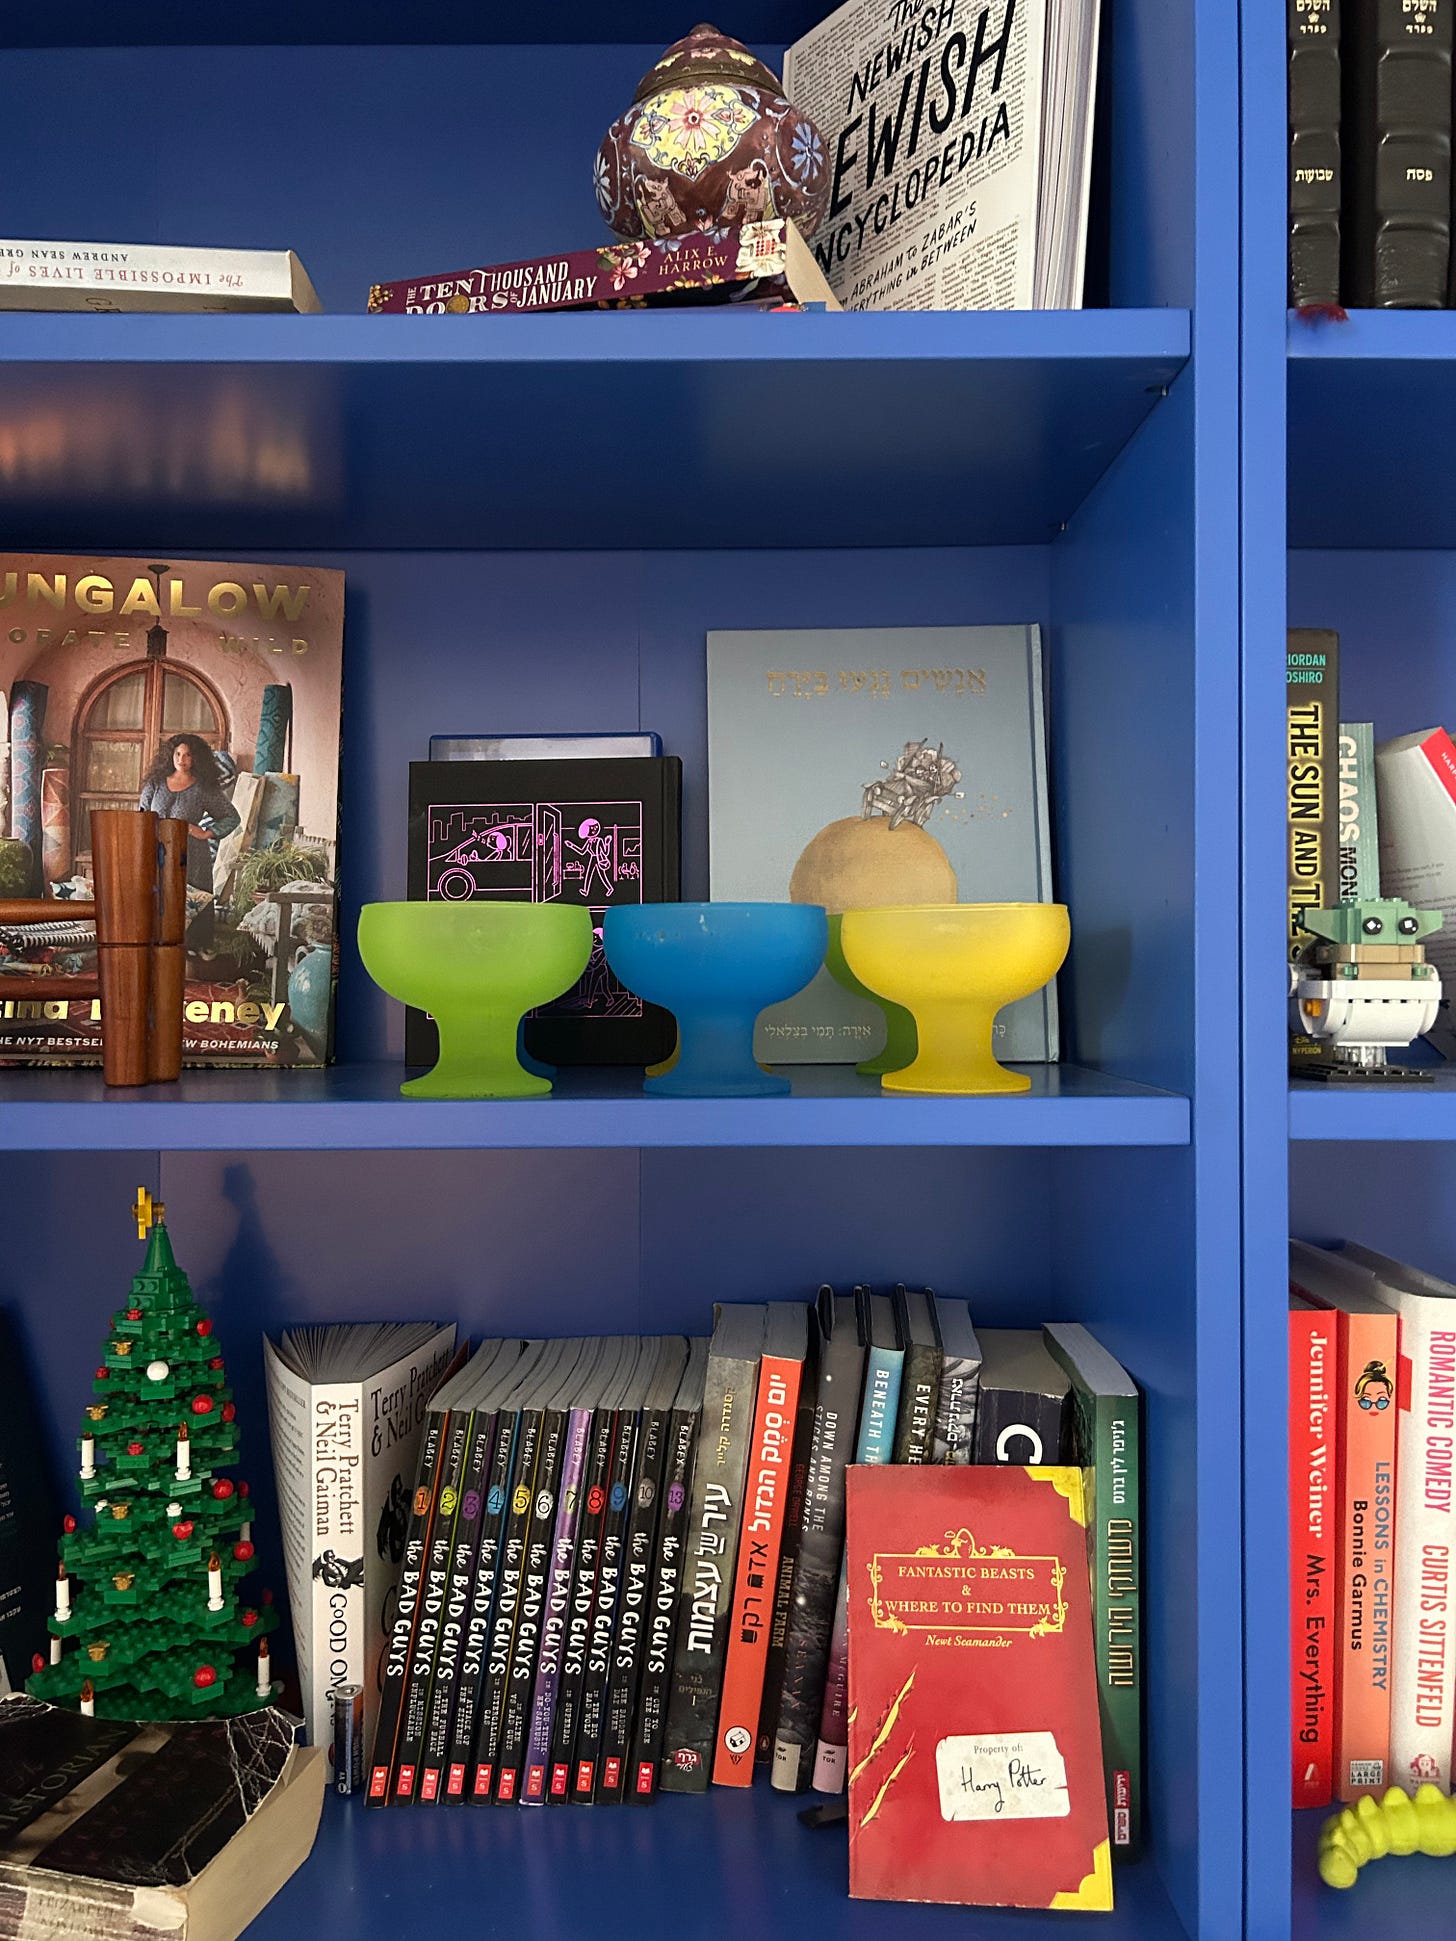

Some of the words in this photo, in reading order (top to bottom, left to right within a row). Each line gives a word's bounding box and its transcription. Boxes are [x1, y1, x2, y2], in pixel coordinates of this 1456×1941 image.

[885, 0, 924, 32] The
[847, 0, 956, 115] NEWISH
[828, 0, 1017, 221] EWISH
[815, 102, 1010, 273] NCYCLOPEDIA
[1295, 168, 1333, 183] שבועות
[1406, 168, 1433, 181] פסח
[31, 248, 65, 260] SEAN
[72, 251, 128, 263] ANDREW
[658, 256, 729, 276] HARROW
[664, 248, 699, 263] ALIX
[852, 254, 904, 297] ABRAHAM
[907, 244, 918, 261] to
[922, 200, 977, 251] ZABAR'S
[906, 264, 918, 279] in
[920, 219, 978, 270] BETWEEN
[7, 260, 21, 278] of
[29, 265, 84, 280] LIVES
[94, 268, 211, 285] IMPOSSIBLE
[219, 273, 244, 287] The
[419, 278, 475, 300] TEN
[470, 261, 569, 293] THOUSAND
[406, 287, 416, 304] THE
[516, 276, 597, 308] JANUARY
[1290, 705, 1320, 758] THE
[1290, 766, 1320, 820] SUN
[1338, 736, 1360, 843] CHAOS
[1292, 831, 1318, 878] AND
[16, 1037, 44, 1045] NYT
[200, 1040, 279, 1050] BOHEMIANS
[1309, 1330, 1328, 1440] Jennifer
[1427, 1331, 1456, 1429] ROMANTIC
[316, 1401, 336, 1416] &
[333, 1399, 358, 1448] Terry
[371, 1387, 407, 1423] Terry
[867, 1369, 890, 1439] BENEATH
[911, 1384, 931, 1441] EVERY
[316, 1422, 336, 1462] Neil
[371, 1425, 382, 1457] &
[387, 1406, 412, 1448] Neil
[497, 1428, 511, 1467] BLABEY
[523, 1428, 537, 1467] BLABEY
[572, 1427, 585, 1466] BLABEY
[597, 1429, 609, 1467] BLABEY
[619, 1425, 632, 1464] BLABEY
[647, 1421, 659, 1460] BLABEY
[676, 1426, 689, 1465] BLABEY
[811, 1405, 824, 1452] STICKS
[822, 1412, 838, 1451] DOWN
[424, 1429, 438, 1468] BLABEY
[450, 1429, 464, 1468] BLABEY
[472, 1433, 486, 1473] BLABEY
[545, 1433, 558, 1472] BLABEY
[1111, 1461, 1128, 1475] לין
[808, 1457, 817, 1483] AND
[816, 1455, 832, 1501] AMONG
[1424, 1436, 1453, 1514] COMEDY
[316, 1467, 337, 1536] Gaiman
[339, 1455, 359, 1535] Pratchett
[417, 1493, 425, 1510] 1
[441, 1492, 455, 1509] 2
[464, 1496, 477, 1514] 3
[489, 1491, 500, 1509] 4
[515, 1490, 527, 1508] 5
[538, 1495, 550, 1514] 6
[566, 1490, 576, 1509] 7
[589, 1490, 600, 1509] 8
[613, 1487, 624, 1505] 9
[640, 1486, 652, 1498] 10
[702, 1483, 732, 1528] עיר
[748, 1469, 777, 1532] הגדול
[802, 1488, 813, 1532] BONES
[1113, 1478, 1125, 1504] ברנס
[1308, 1444, 1328, 1539] Weiner
[1374, 1462, 1390, 1549] LESSONS
[812, 1507, 826, 1532] THE
[1352, 1500, 1368, 1568] Bonnie
[407, 1540, 423, 1565] the
[434, 1539, 449, 1564] the
[456, 1543, 472, 1568] the
[482, 1539, 497, 1563] the
[507, 1539, 523, 1563] the
[531, 1543, 546, 1568] the
[557, 1538, 573, 1563] the
[582, 1539, 598, 1563] the
[605, 1536, 621, 1560] the
[633, 1532, 649, 1557] the
[663, 1536, 679, 1561] the
[1108, 1519, 1136, 1597] משחקי
[627, 1564, 645, 1605] BAD
[776, 1556, 794, 1608] ANIMAL
[898, 1566, 977, 1579] FANTASTIC
[980, 1568, 1035, 1580] BEASTS
[1305, 1554, 1326, 1605] Mrs.
[1374, 1559, 1388, 1573] in
[1421, 1545, 1449, 1612] CURTIS
[399, 1571, 419, 1613] BAD
[425, 1570, 446, 1613] BAD
[449, 1575, 468, 1617] BAD
[474, 1570, 494, 1612] BAD
[500, 1570, 519, 1612] BAD
[523, 1575, 543, 1617] BAD
[550, 1569, 569, 1611] BAD
[575, 1570, 594, 1612] BAD
[599, 1567, 617, 1609] BAD
[657, 1568, 676, 1610] BAD
[687, 1560, 722, 1654] עצמות
[885, 1600, 939, 1613] WHERE
[942, 1602, 963, 1614] TO
[967, 1602, 1004, 1615] FIND
[1007, 1603, 1051, 1615] THEM
[961, 1584, 972, 1596] &
[772, 1611, 787, 1648] FARM
[1351, 1574, 1367, 1651] Garmus
[387, 1619, 411, 1676] GUYS
[414, 1619, 438, 1675] GUYS
[438, 1623, 461, 1680] GUYS
[463, 1618, 487, 1675] GUYS
[489, 1618, 512, 1675] GUYS
[513, 1623, 537, 1679] GUYS
[540, 1618, 563, 1674] GUYS
[565, 1618, 588, 1675] GUYS
[589, 1615, 612, 1672] GUYS
[617, 1612, 640, 1668] GUYS
[648, 1616, 671, 1673] GUYS
[925, 1634, 951, 1647] Newt
[953, 1635, 1013, 1648] Scamander
[1108, 1607, 1134, 1686] הירושה
[1372, 1577, 1388, 1691] CHEMISTRY
[1299, 1616, 1326, 1743] Everything
[1416, 1619, 1446, 1728] SITTENFELD
[775, 1753, 787, 1761] TOR
[822, 1756, 836, 1764] TOR
[973, 1745, 1009, 1756] Property
[961, 1765, 1005, 1813] Harry
[1008, 1758, 1047, 1788] Potter
